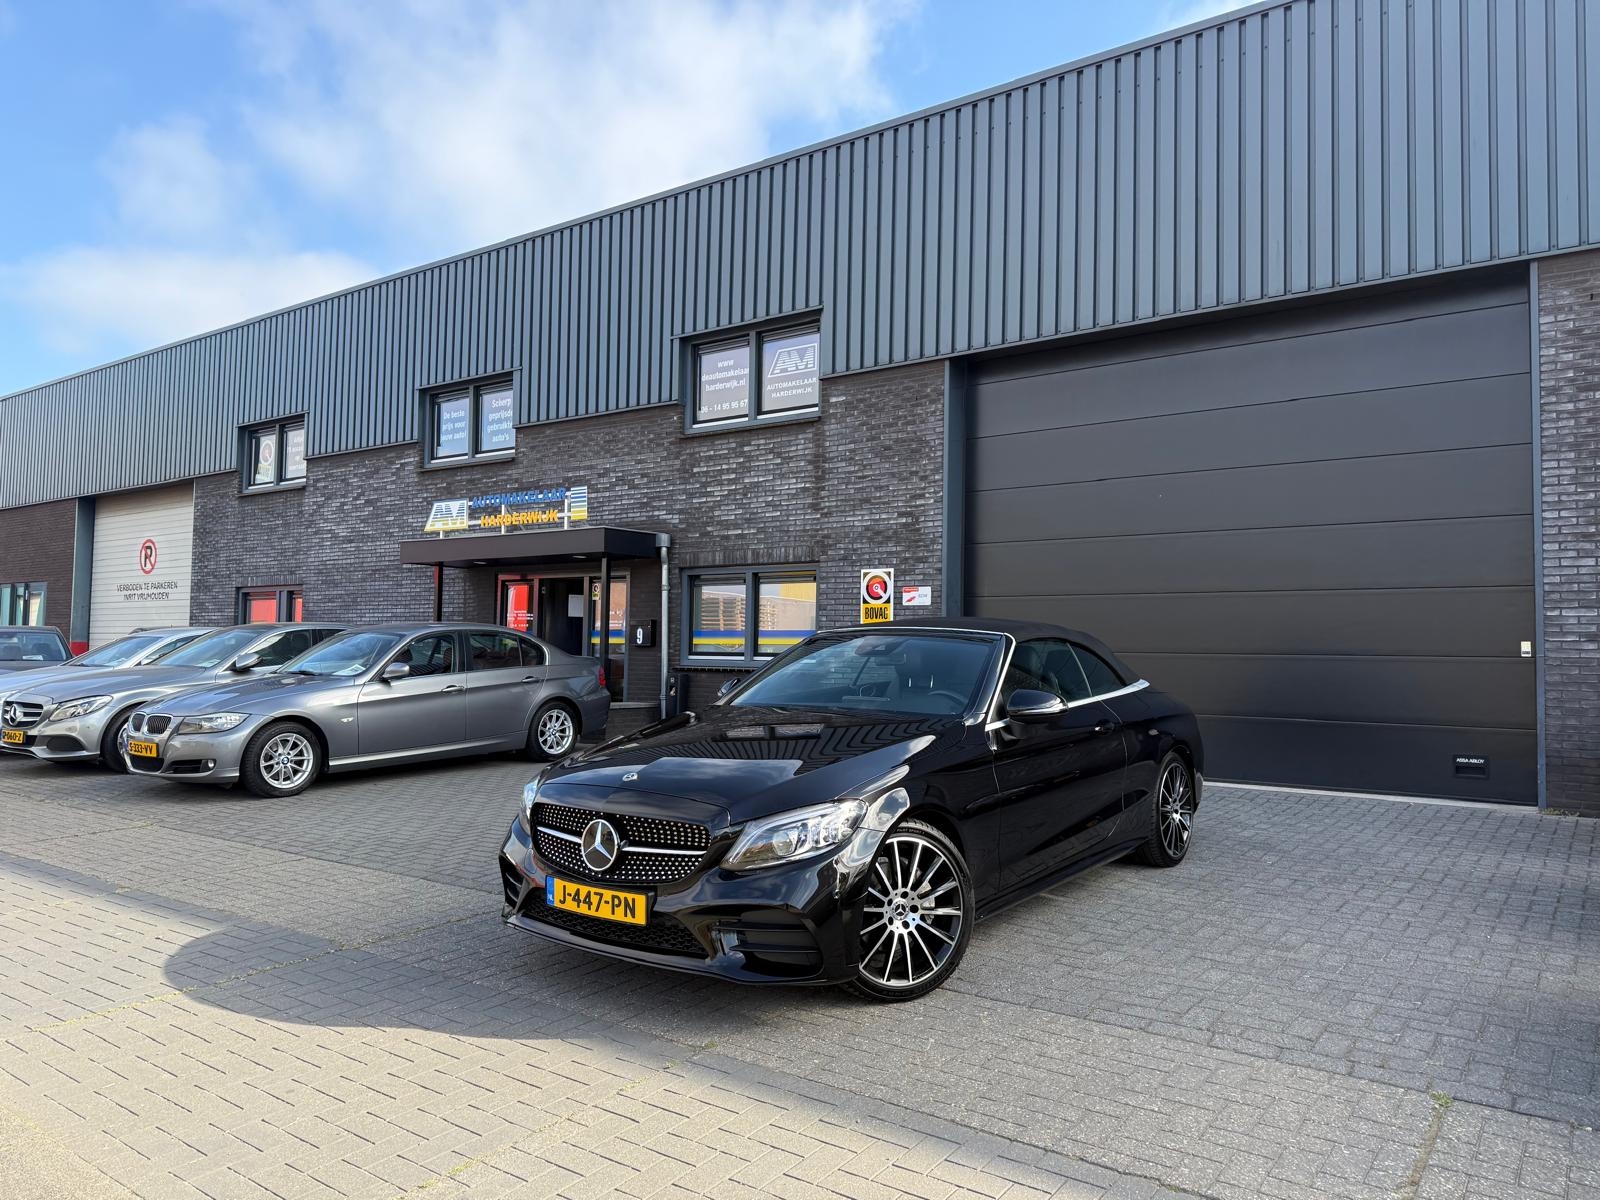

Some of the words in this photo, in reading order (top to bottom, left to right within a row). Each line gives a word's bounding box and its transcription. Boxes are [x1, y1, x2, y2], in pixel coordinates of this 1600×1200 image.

[717, 359, 734, 368] www
[705, 378, 746, 391] harderwijk.nl
[766, 377, 817, 390] AUTOMAKELAAR
[771, 386, 813, 398] HARDERWIJK
[714, 403, 721, 411] 14
[472, 488, 566, 509] AUTOMAKELAAR
[480, 510, 559, 528] HARDERWIJK
[116, 583, 143, 592] VERBODEN
[143, 582, 150, 590] TE
[150, 581, 178, 590] PARKEREN
[864, 606, 889, 620] BOVAG
[636, 627, 643, 645] 9
[559, 884, 636, 919] J-447-PN
